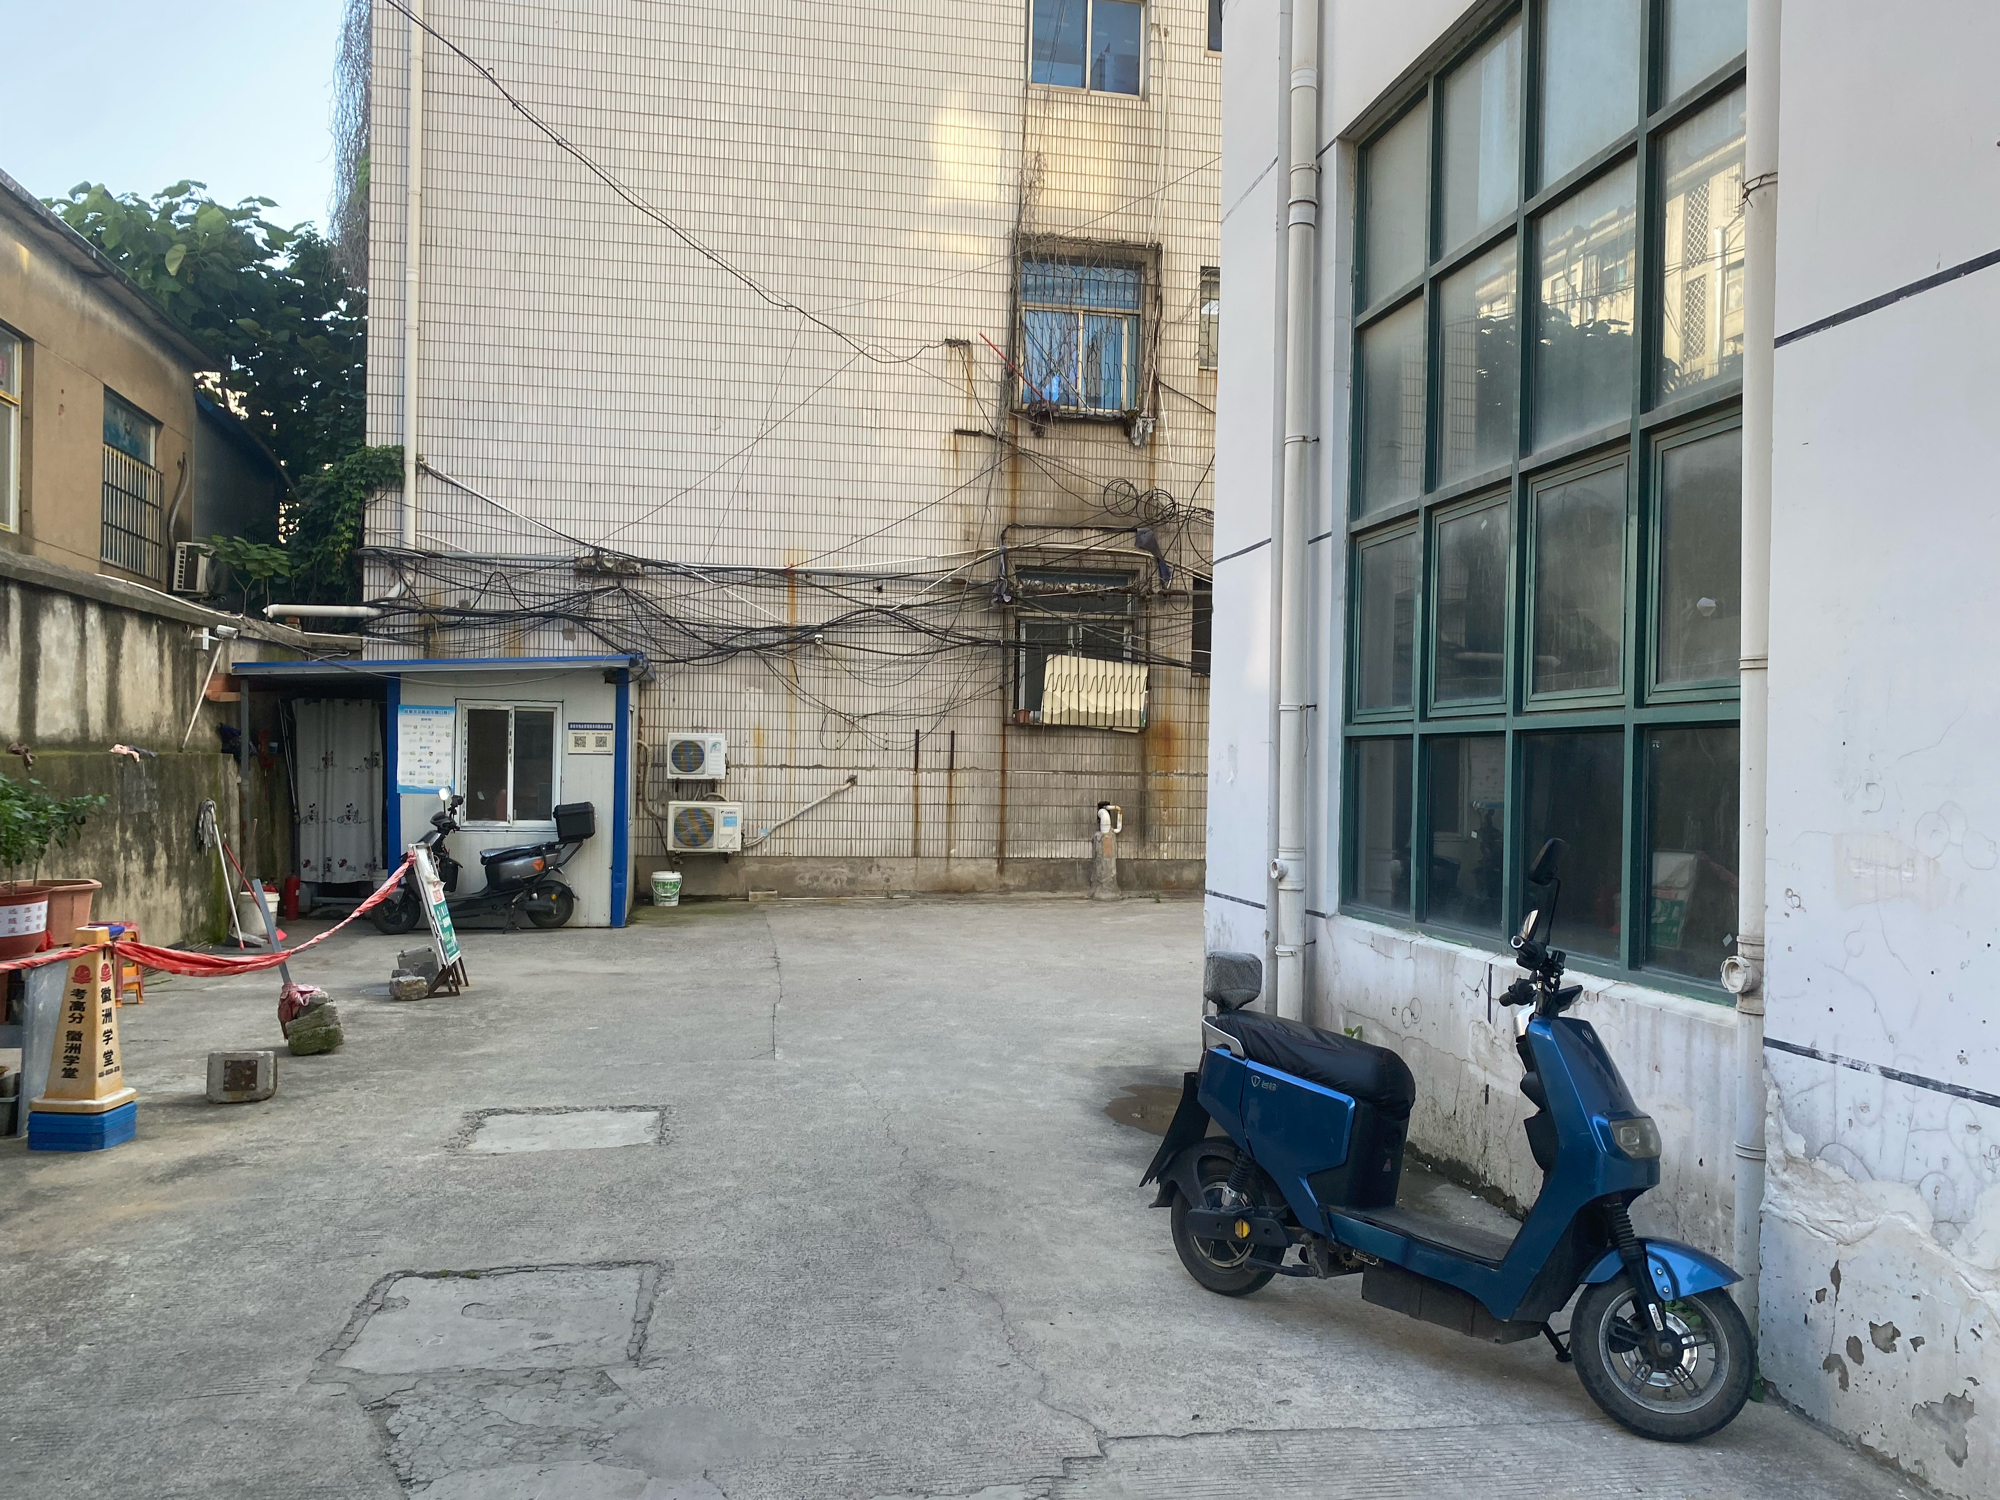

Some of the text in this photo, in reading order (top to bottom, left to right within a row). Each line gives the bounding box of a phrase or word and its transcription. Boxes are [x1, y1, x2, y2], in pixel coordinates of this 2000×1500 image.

[61, 988, 88, 1079] 考高分 徽洲学堂
[100, 986, 115, 1068] 徽洲学堂
